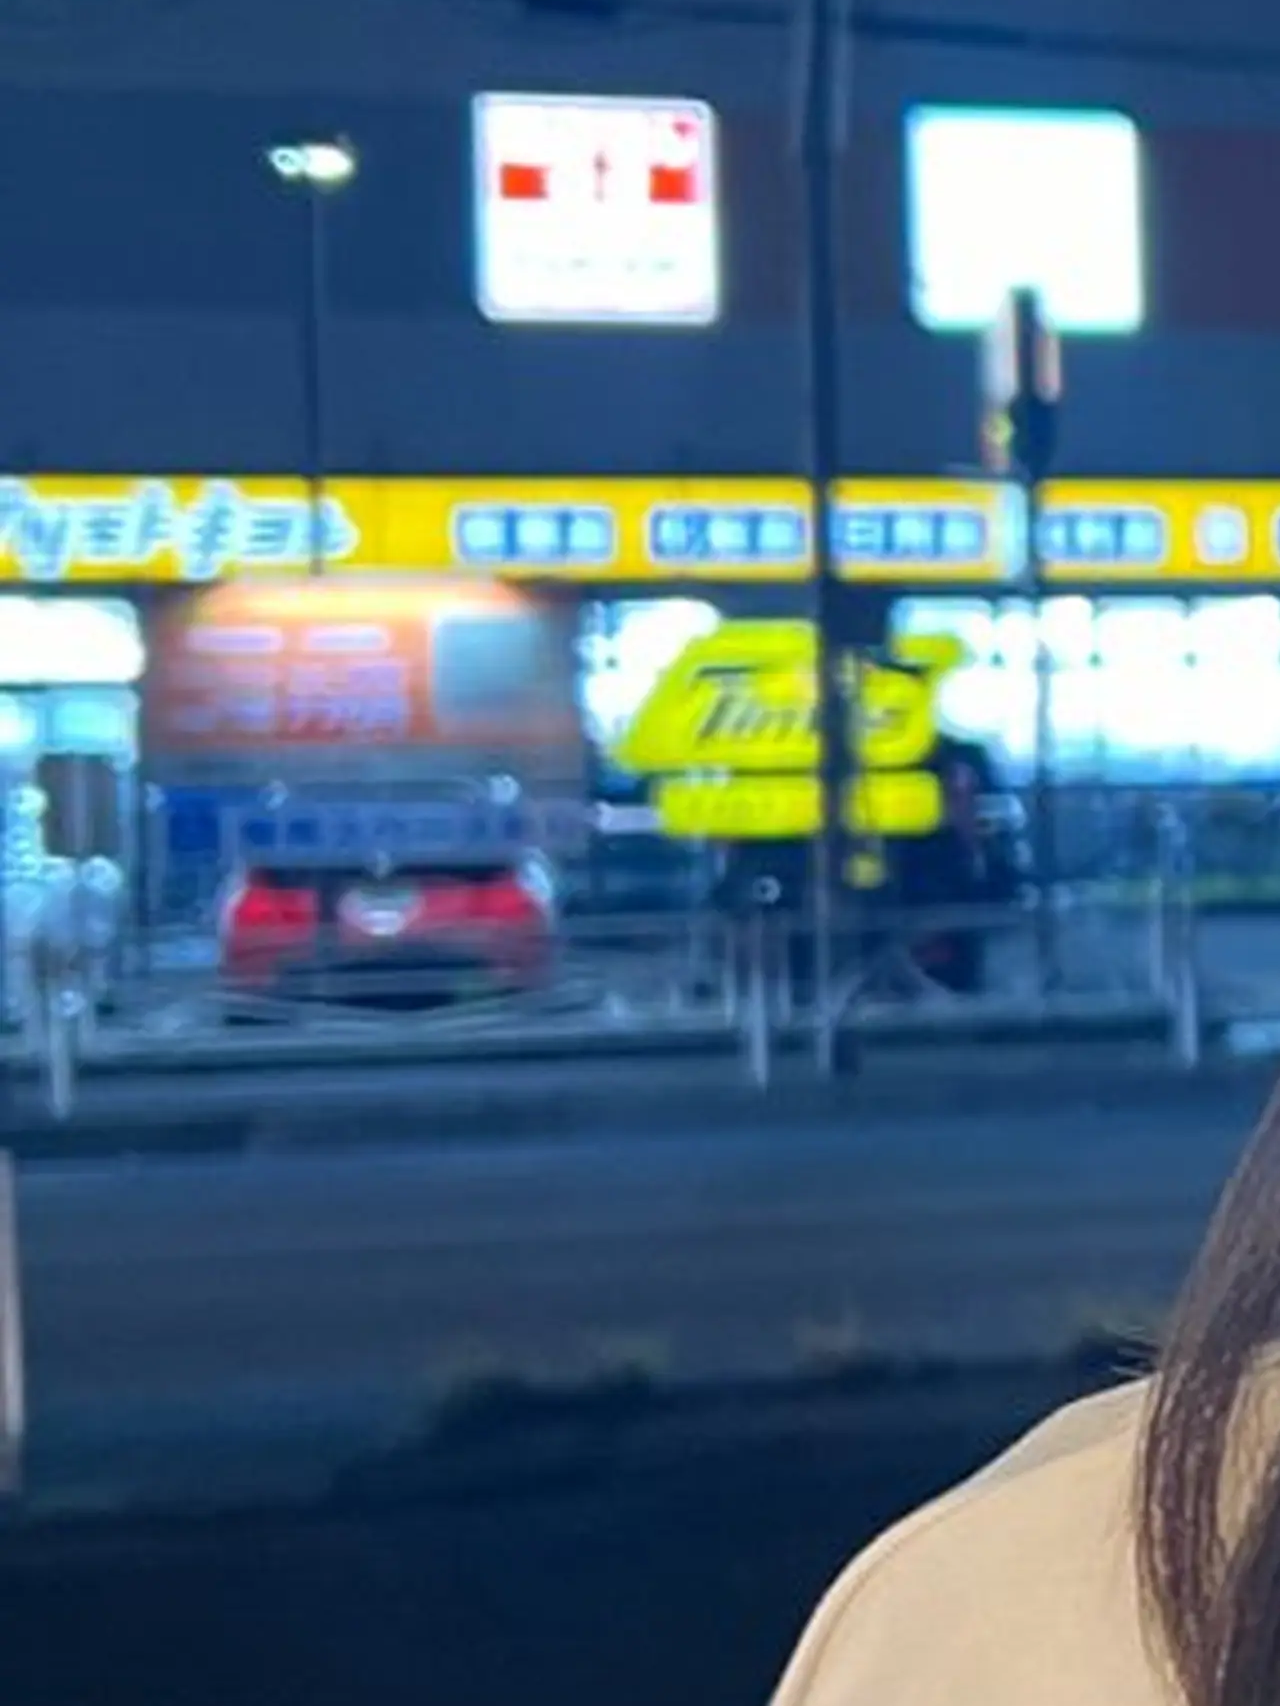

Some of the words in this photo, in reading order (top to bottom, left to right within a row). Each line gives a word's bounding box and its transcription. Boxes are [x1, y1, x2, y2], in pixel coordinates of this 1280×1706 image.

[0, 483, 352, 577] ツモトキヨ
[690, 663, 910, 743] Tims
